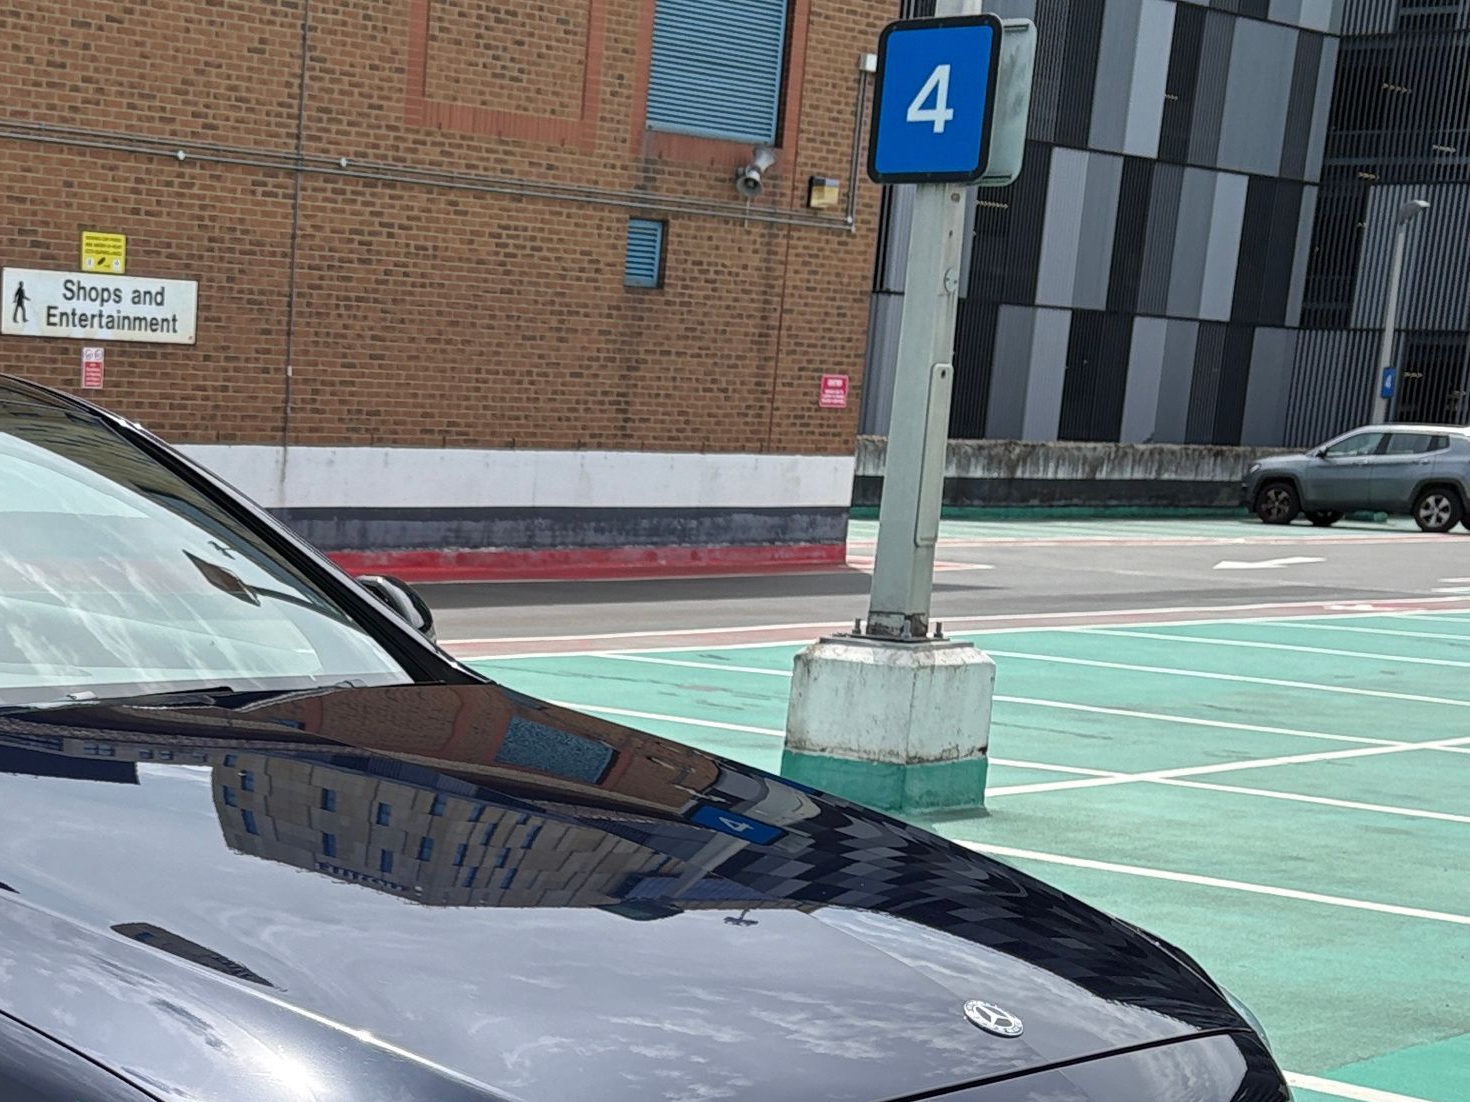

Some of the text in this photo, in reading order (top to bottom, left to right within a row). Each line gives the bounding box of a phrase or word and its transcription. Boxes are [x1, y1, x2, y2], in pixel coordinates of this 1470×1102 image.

[906, 64, 954, 134] 4
[62, 279, 165, 307] Shops and
[46, 305, 178, 334] Entertainment
